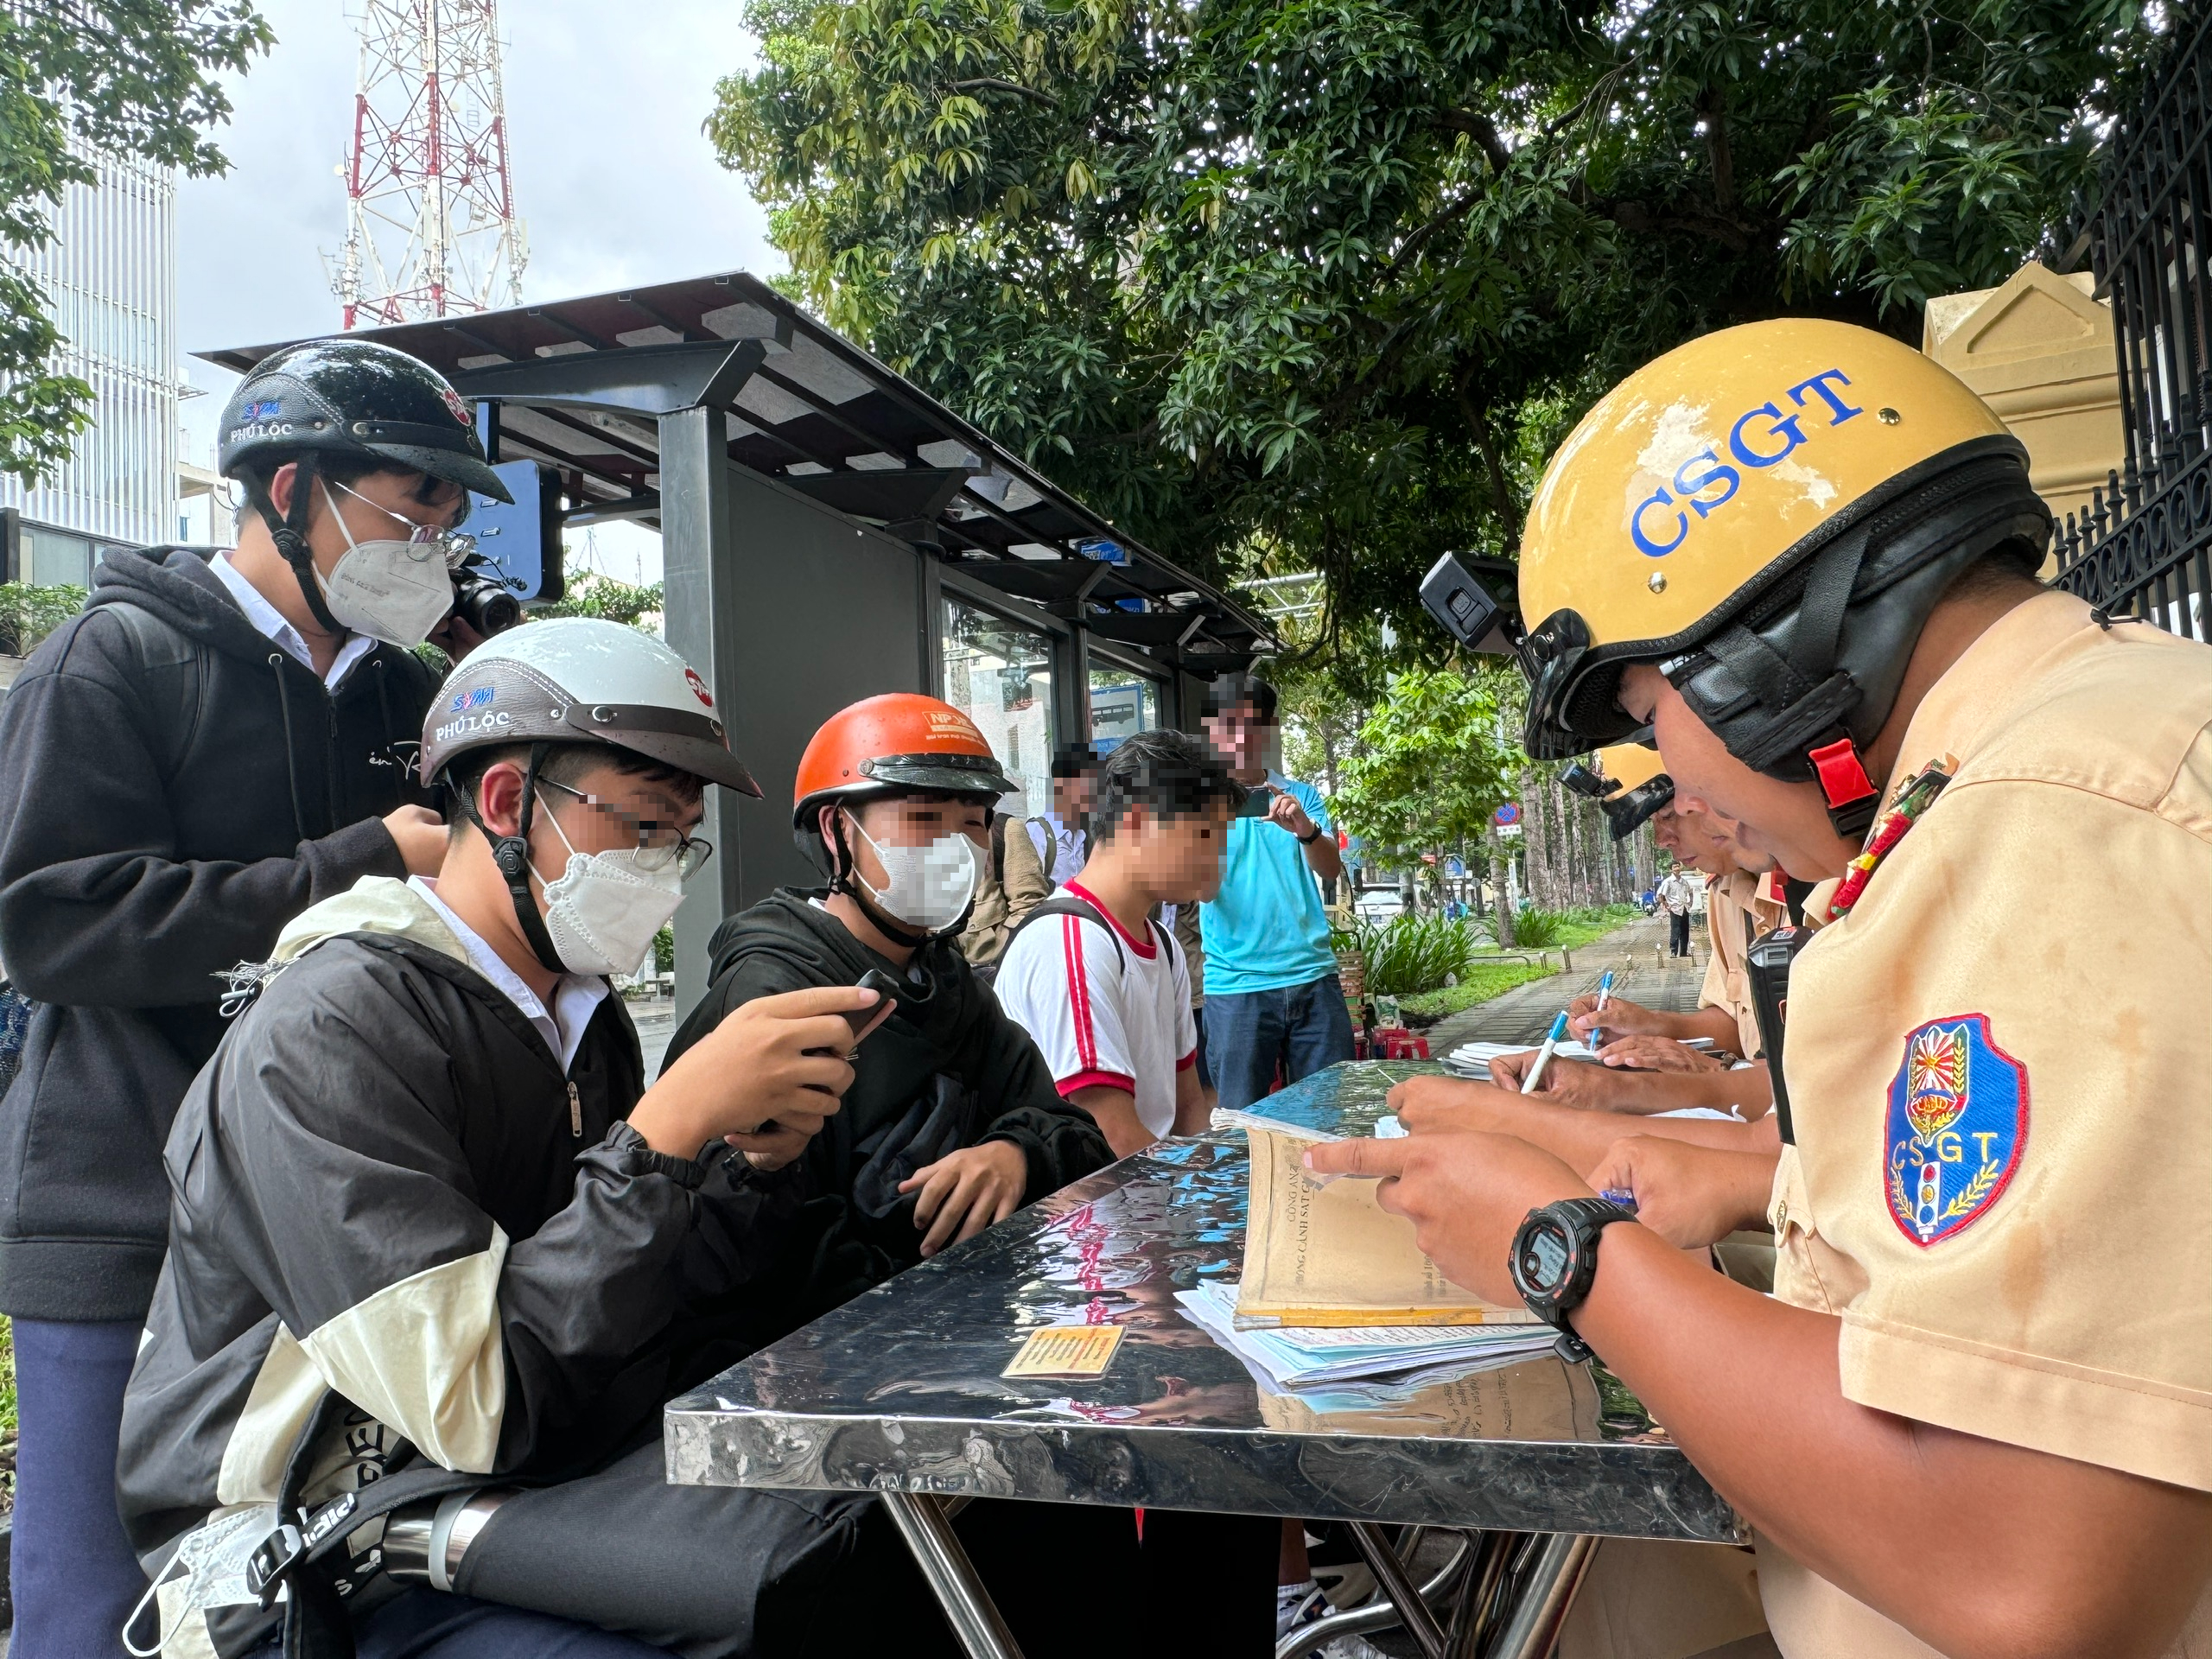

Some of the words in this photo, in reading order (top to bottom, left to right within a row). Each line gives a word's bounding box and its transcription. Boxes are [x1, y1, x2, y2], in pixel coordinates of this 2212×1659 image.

[1630, 368, 1864, 558] CSGT
[435, 715, 466, 741] PHÚ
[465, 710, 511, 733] LỘC
[1892, 1131, 1999, 1170] CSGT
